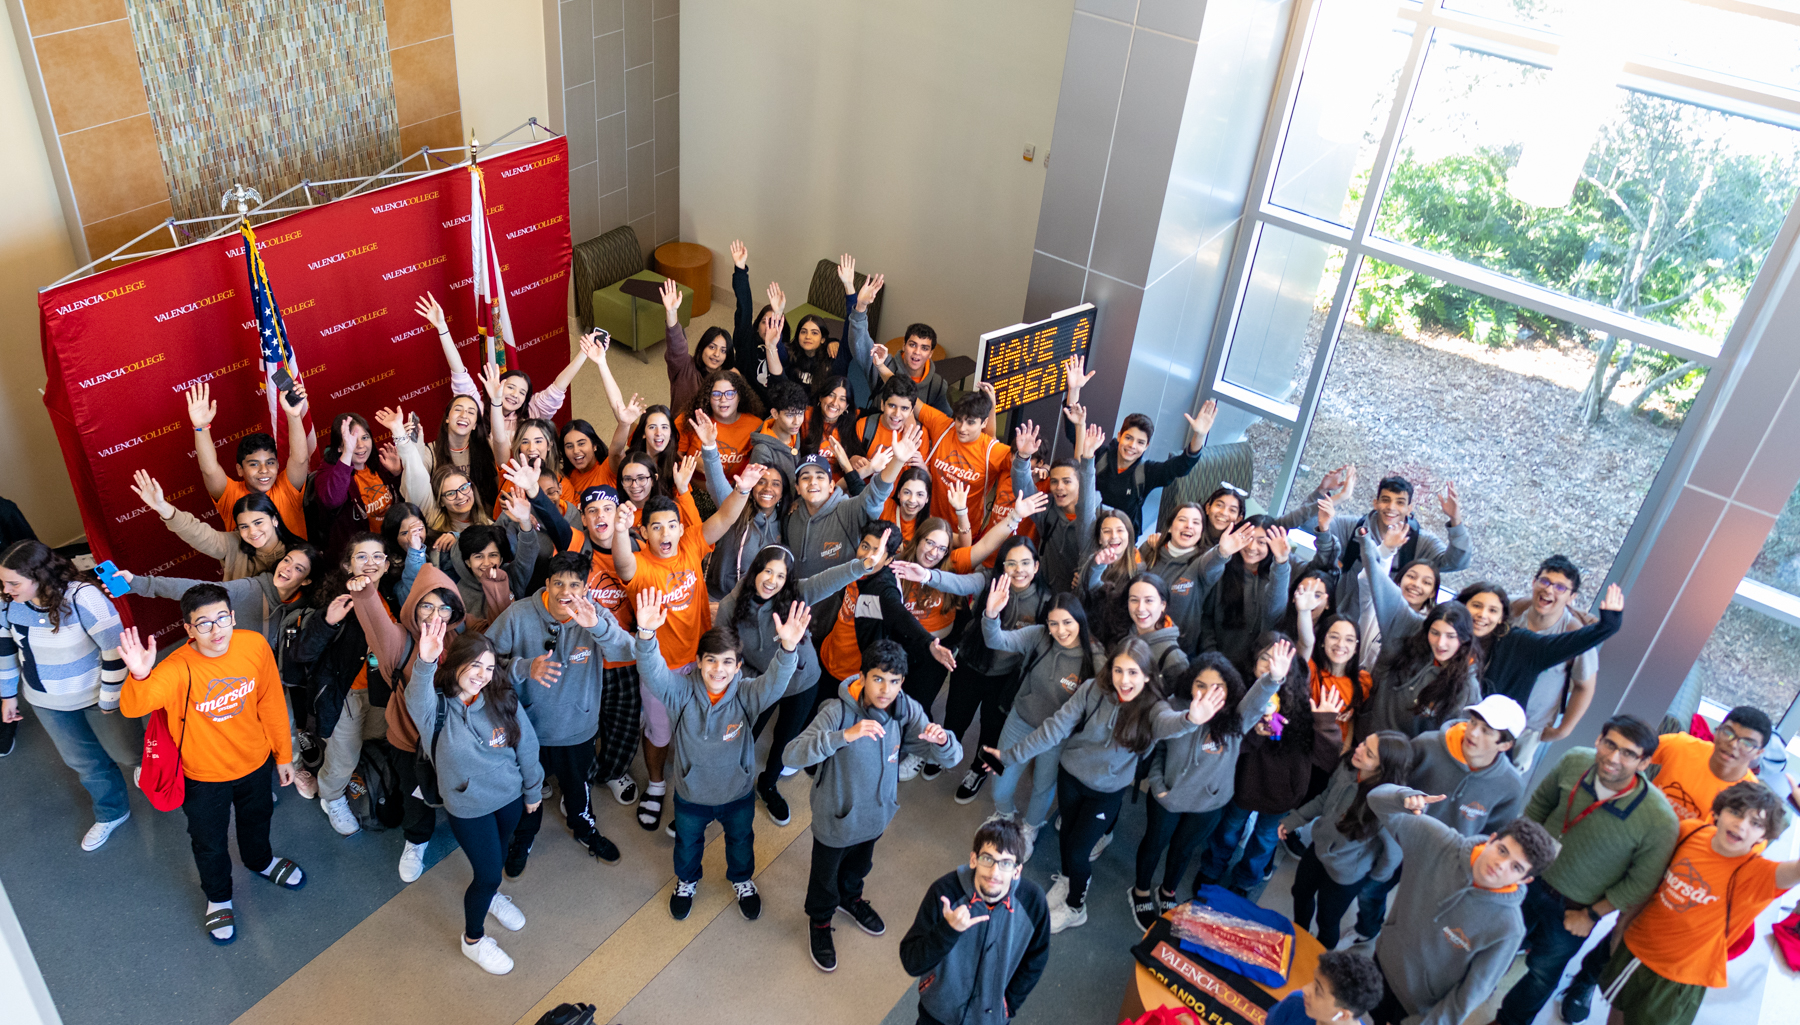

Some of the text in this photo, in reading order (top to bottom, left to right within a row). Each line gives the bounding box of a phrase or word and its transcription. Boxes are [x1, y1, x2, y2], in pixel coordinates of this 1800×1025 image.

[987, 317, 1090, 379] HAVE A
[993, 355, 1077, 413] GREAT
[196, 679, 255, 713] imersão
